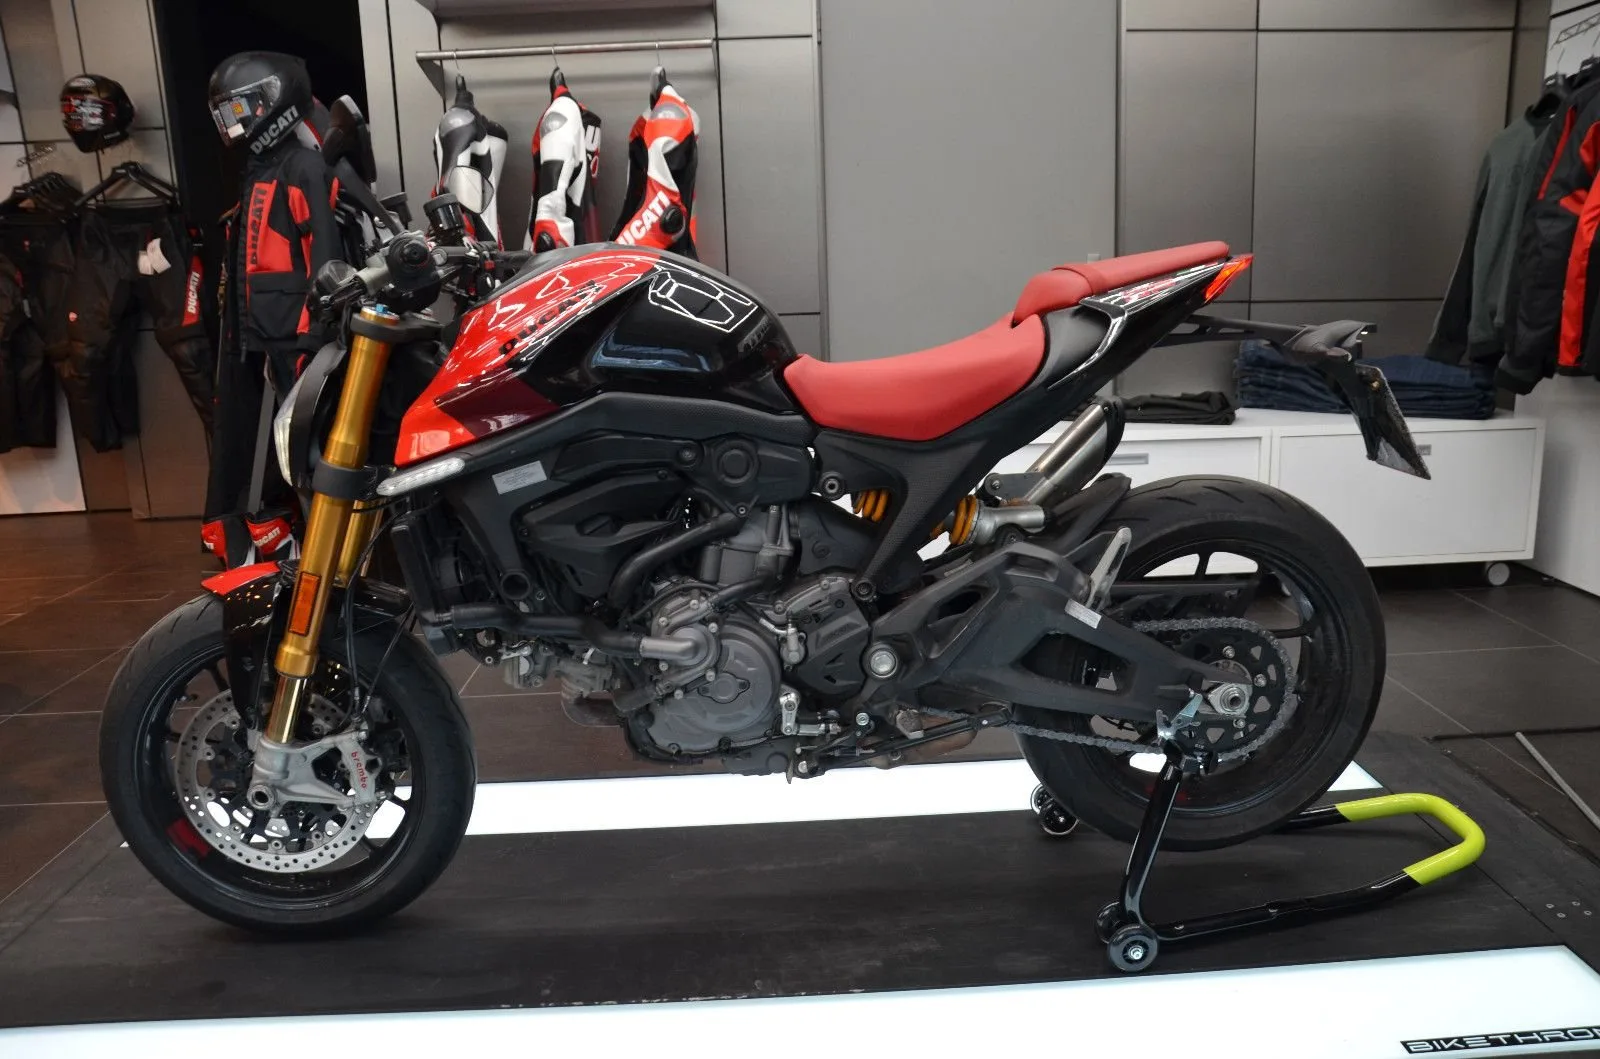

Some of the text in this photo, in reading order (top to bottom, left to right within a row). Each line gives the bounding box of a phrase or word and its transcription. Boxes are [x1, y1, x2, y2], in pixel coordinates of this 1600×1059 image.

[250, 105, 299, 154] DUCATI
[251, 187, 267, 265] DUCATI
[616, 190, 671, 246] UCATI
[187, 271, 200, 314] DUCATI
[351, 751, 368, 790] brembo
